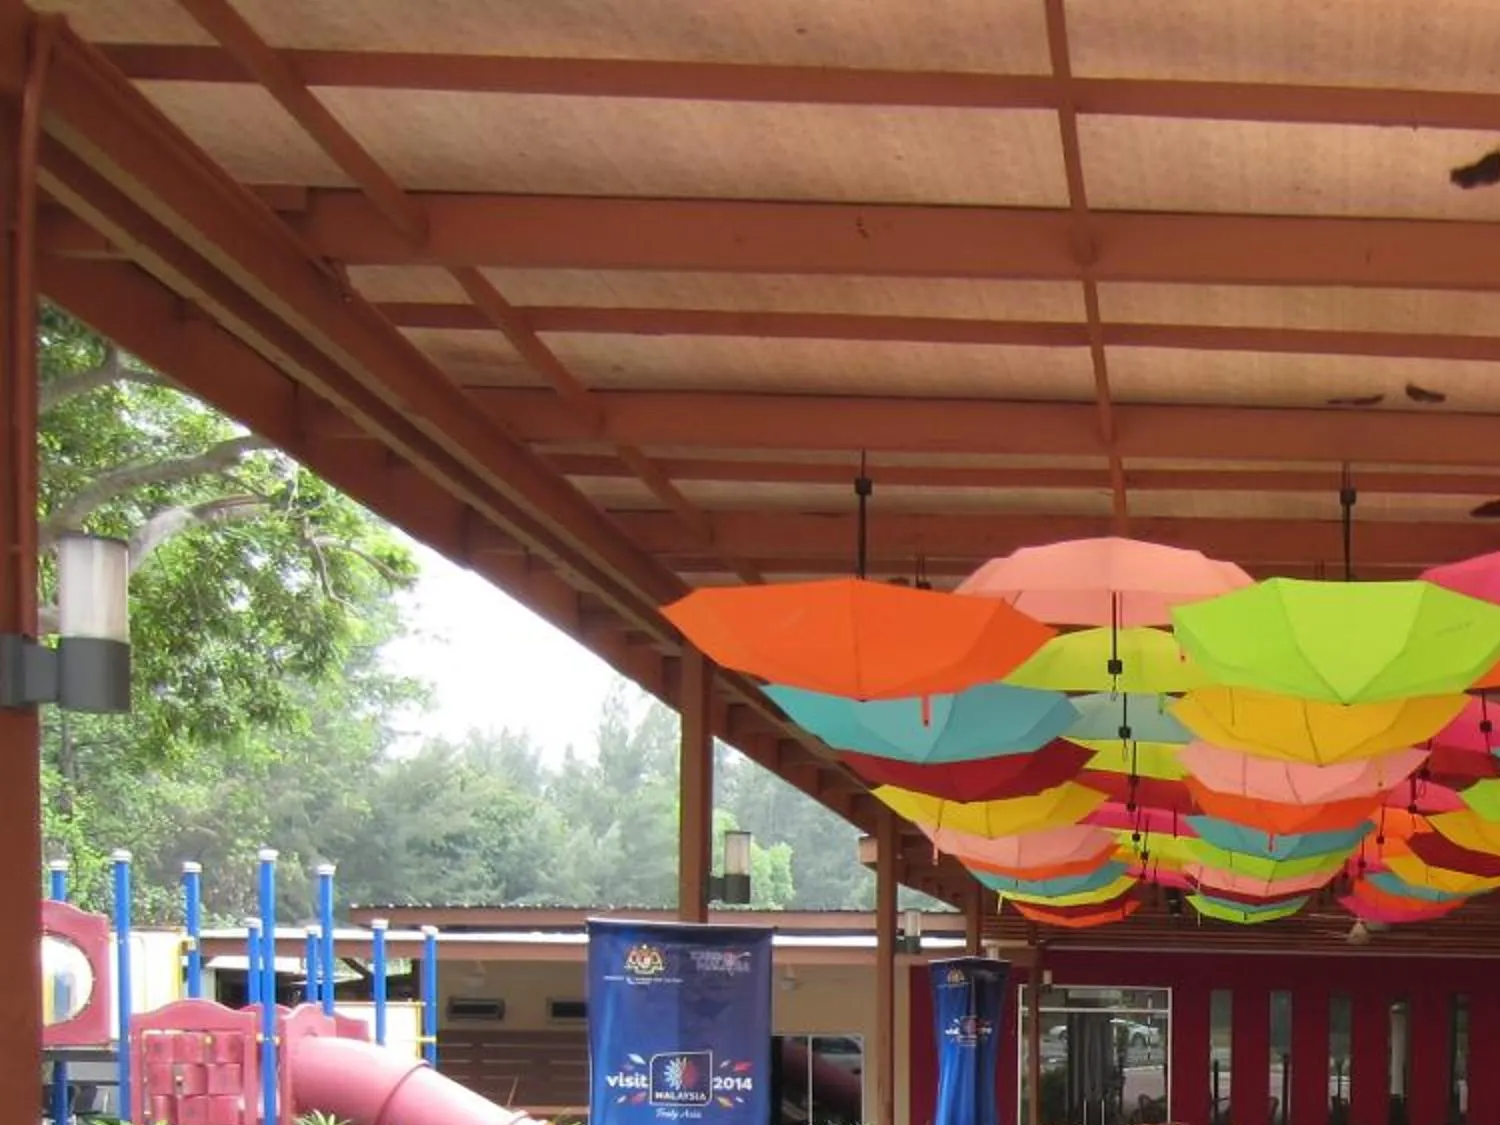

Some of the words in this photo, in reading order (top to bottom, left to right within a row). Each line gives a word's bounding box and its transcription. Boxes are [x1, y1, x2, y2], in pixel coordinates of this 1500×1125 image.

[606, 1072, 649, 1088] visit
[712, 1076, 753, 1090] 2014
[655, 1091, 707, 1102] MALAYSIA
[655, 1108, 679, 1120] Truly
[680, 1109, 702, 1119] Asia
